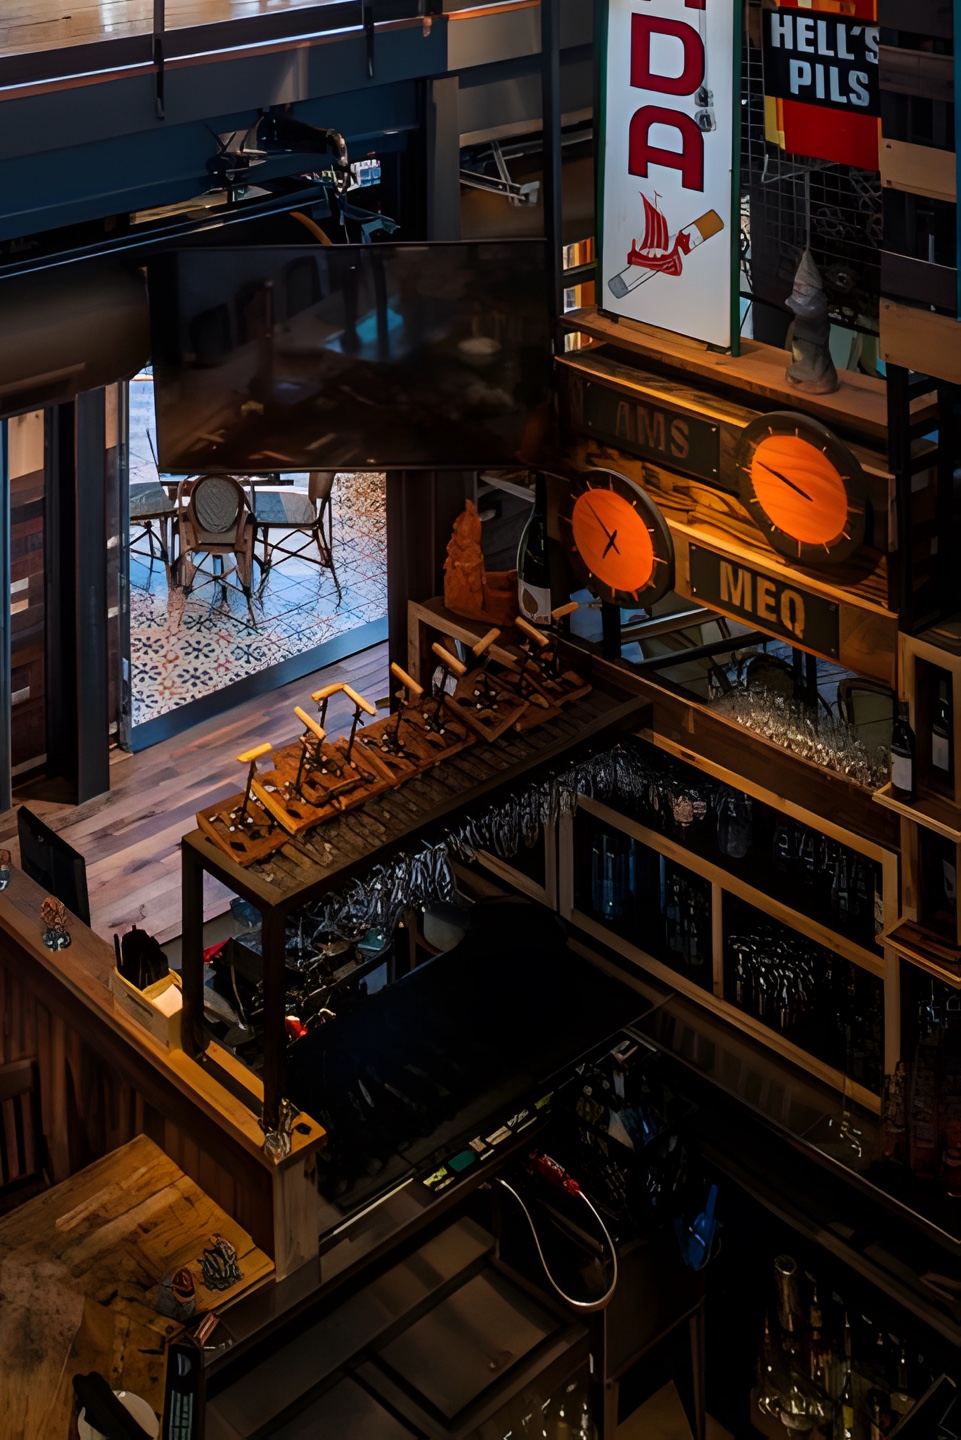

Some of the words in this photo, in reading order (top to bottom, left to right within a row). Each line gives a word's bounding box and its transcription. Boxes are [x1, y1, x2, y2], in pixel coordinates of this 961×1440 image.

[770, 12, 880, 63] HELL'S
[788, 59, 871, 108] PILS
[615, 399, 690, 459] AMS
[719, 560, 806, 639] MEQ
